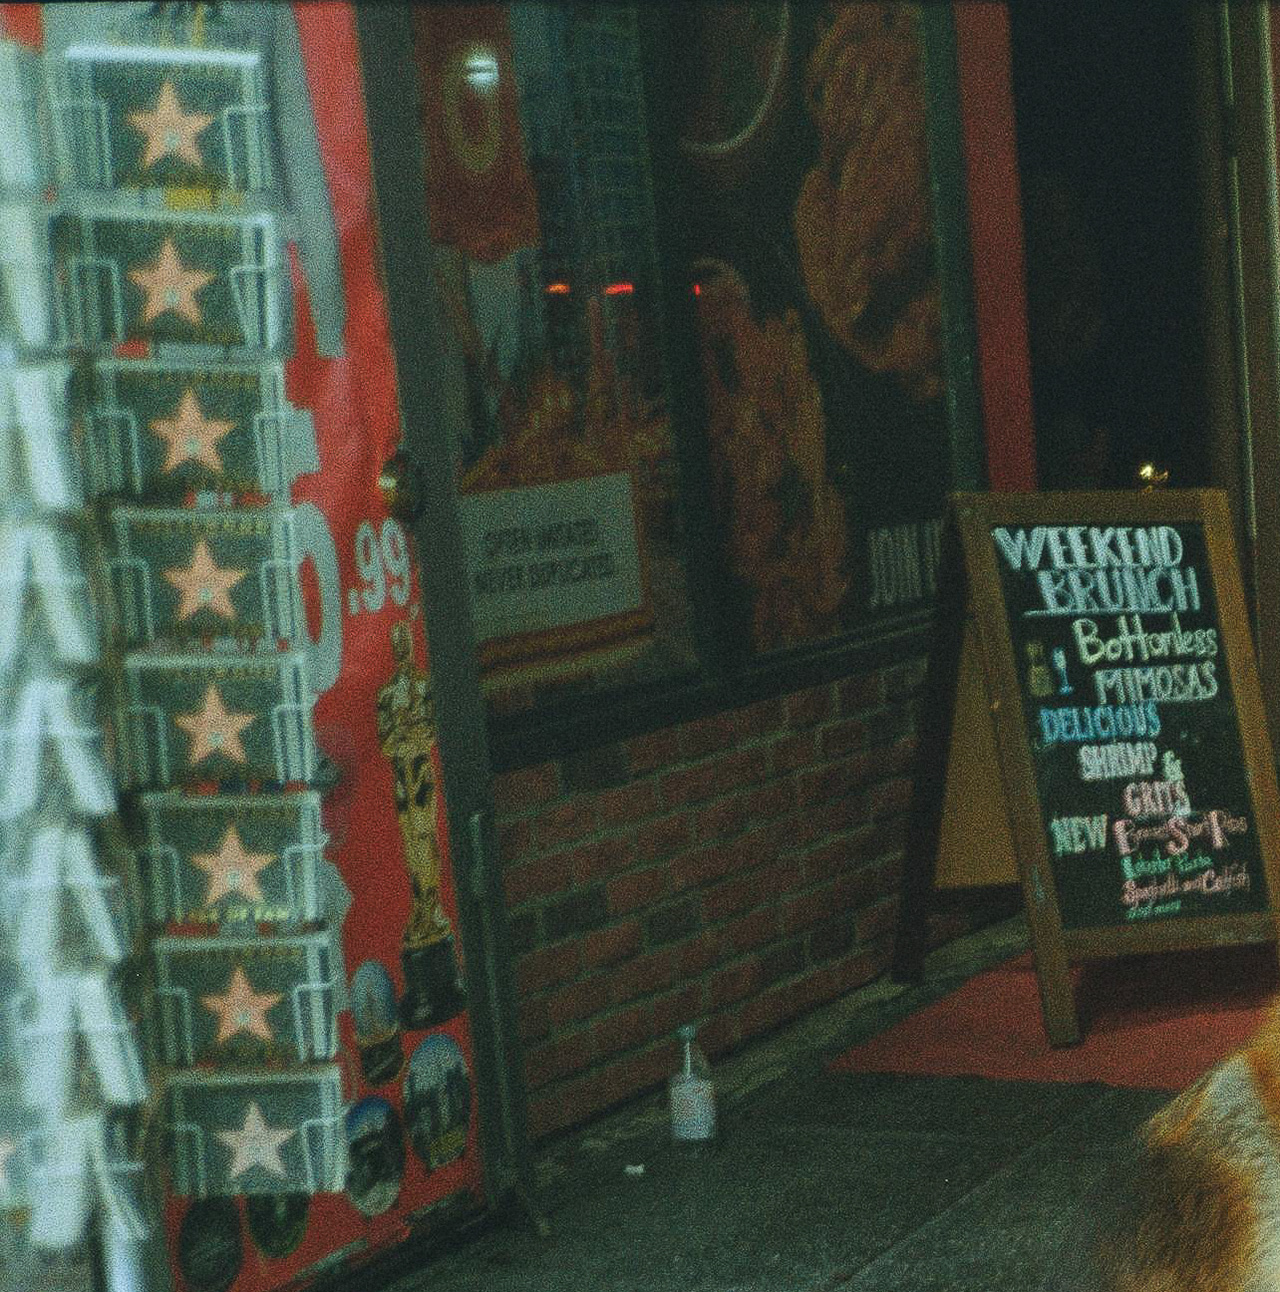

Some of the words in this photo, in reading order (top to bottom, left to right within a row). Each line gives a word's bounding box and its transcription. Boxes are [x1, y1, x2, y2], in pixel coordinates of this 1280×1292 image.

[991, 525, 1183, 569] WEEKEND
[1037, 567, 1200, 612] BRUNCH
[1094, 661, 1218, 704] MIMOSAS
[1040, 701, 1161, 743] DELICIOUS
[1079, 743, 1157, 780] SHRIMP
[1124, 781, 1191, 816] GRITS
[1050, 814, 1108, 856] NEW
